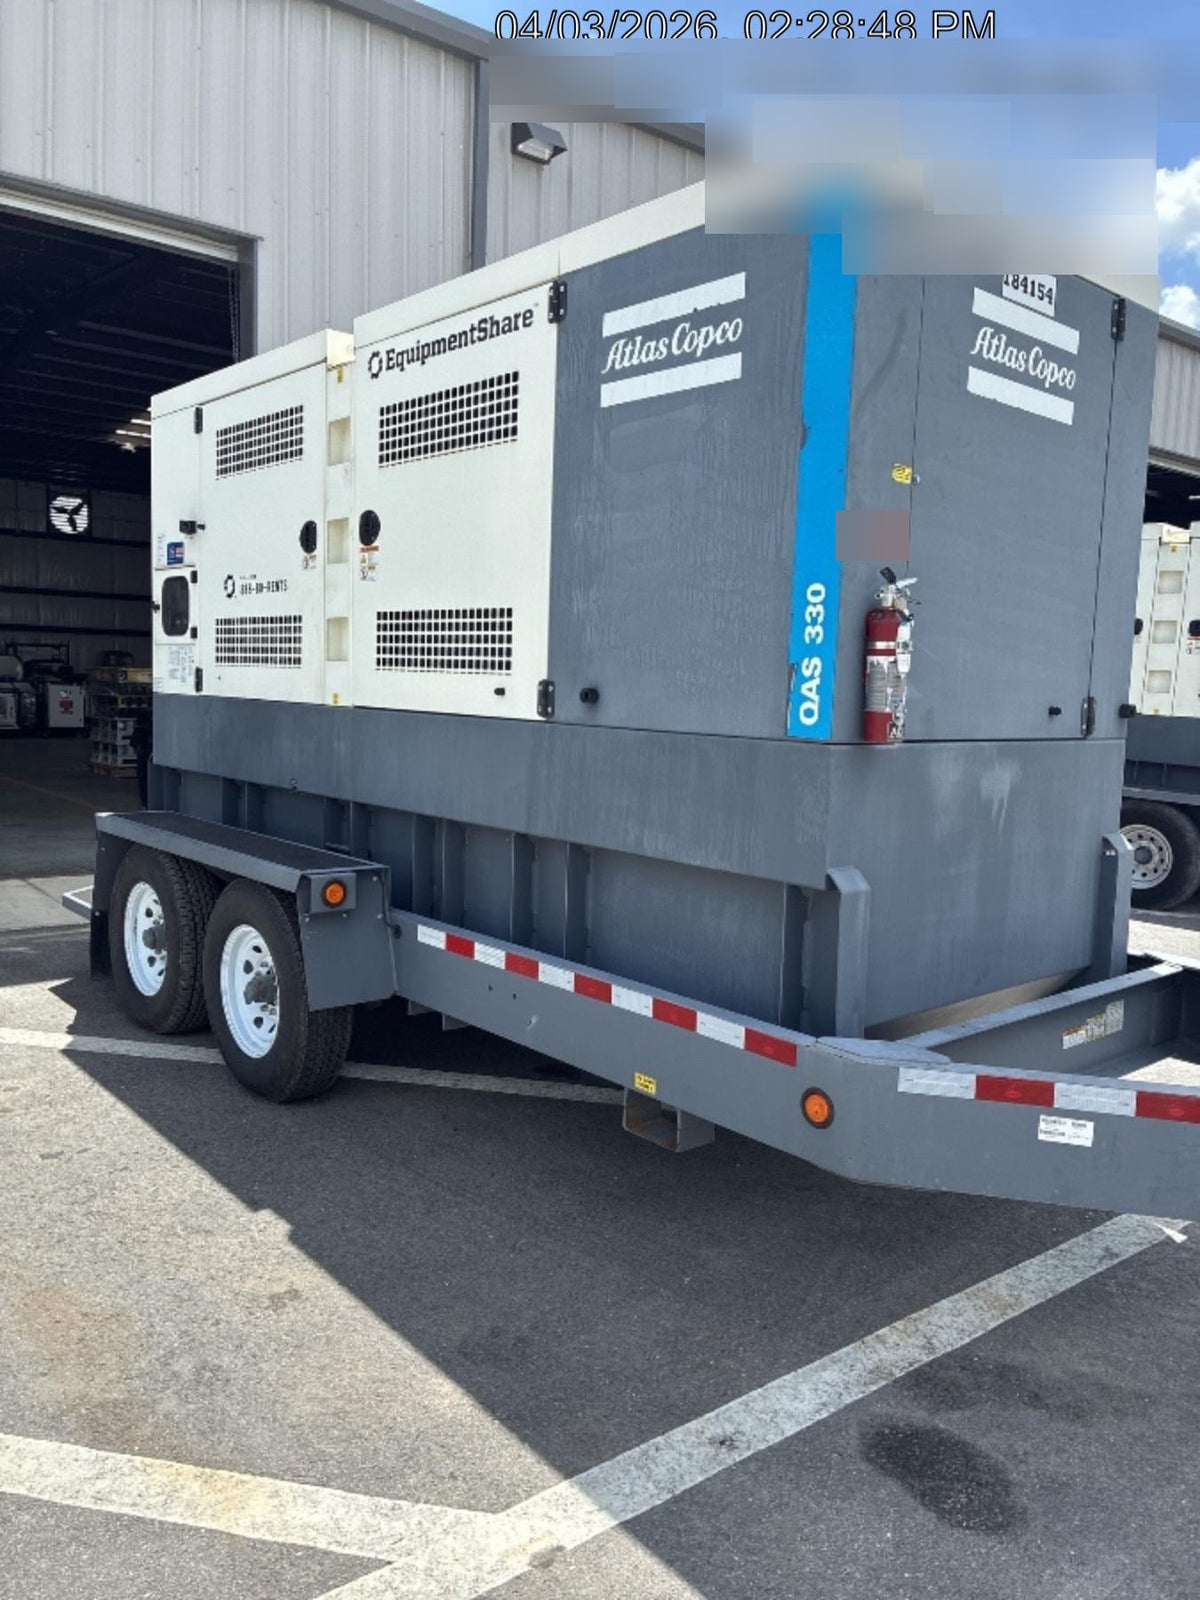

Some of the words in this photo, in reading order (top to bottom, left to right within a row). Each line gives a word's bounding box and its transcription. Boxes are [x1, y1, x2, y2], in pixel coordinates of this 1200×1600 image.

[1004, 274, 1053, 305] 184154
[386, 308, 534, 372] EquipmentShare
[601, 335, 669, 374] Atlas
[671, 318, 743, 358] Copco
[970, 326, 1027, 372] Atlas
[1028, 346, 1076, 390] Copco
[804, 582, 826, 645] 330
[799, 656, 822, 726] QAS
